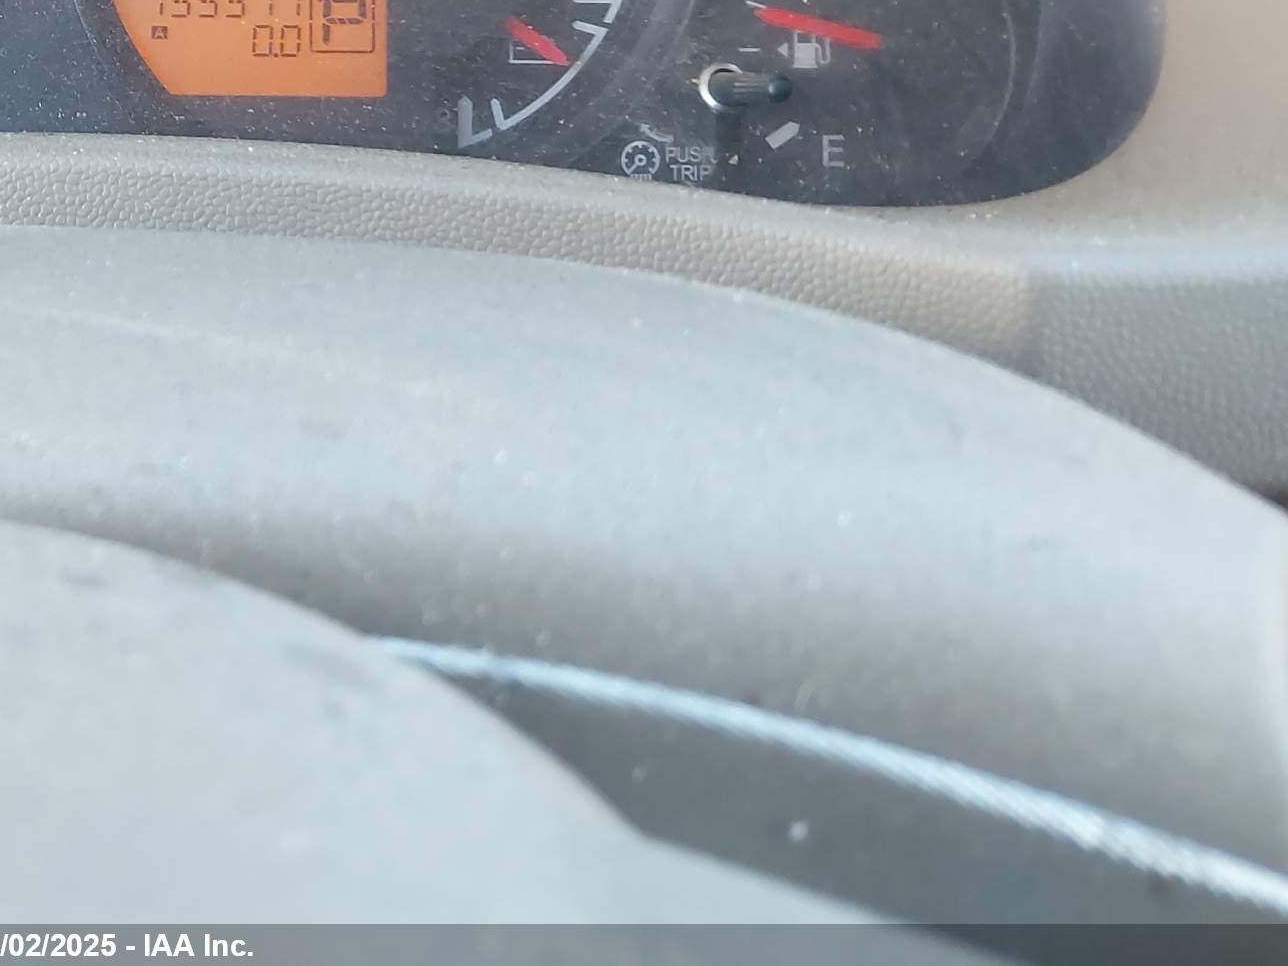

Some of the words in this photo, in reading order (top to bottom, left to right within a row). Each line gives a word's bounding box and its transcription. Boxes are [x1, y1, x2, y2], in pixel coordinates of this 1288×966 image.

[151, 25, 168, 40] A
[251, 24, 303, 58] 0.0
[821, 134, 846, 168] E
[669, 163, 712, 182] TRIP
